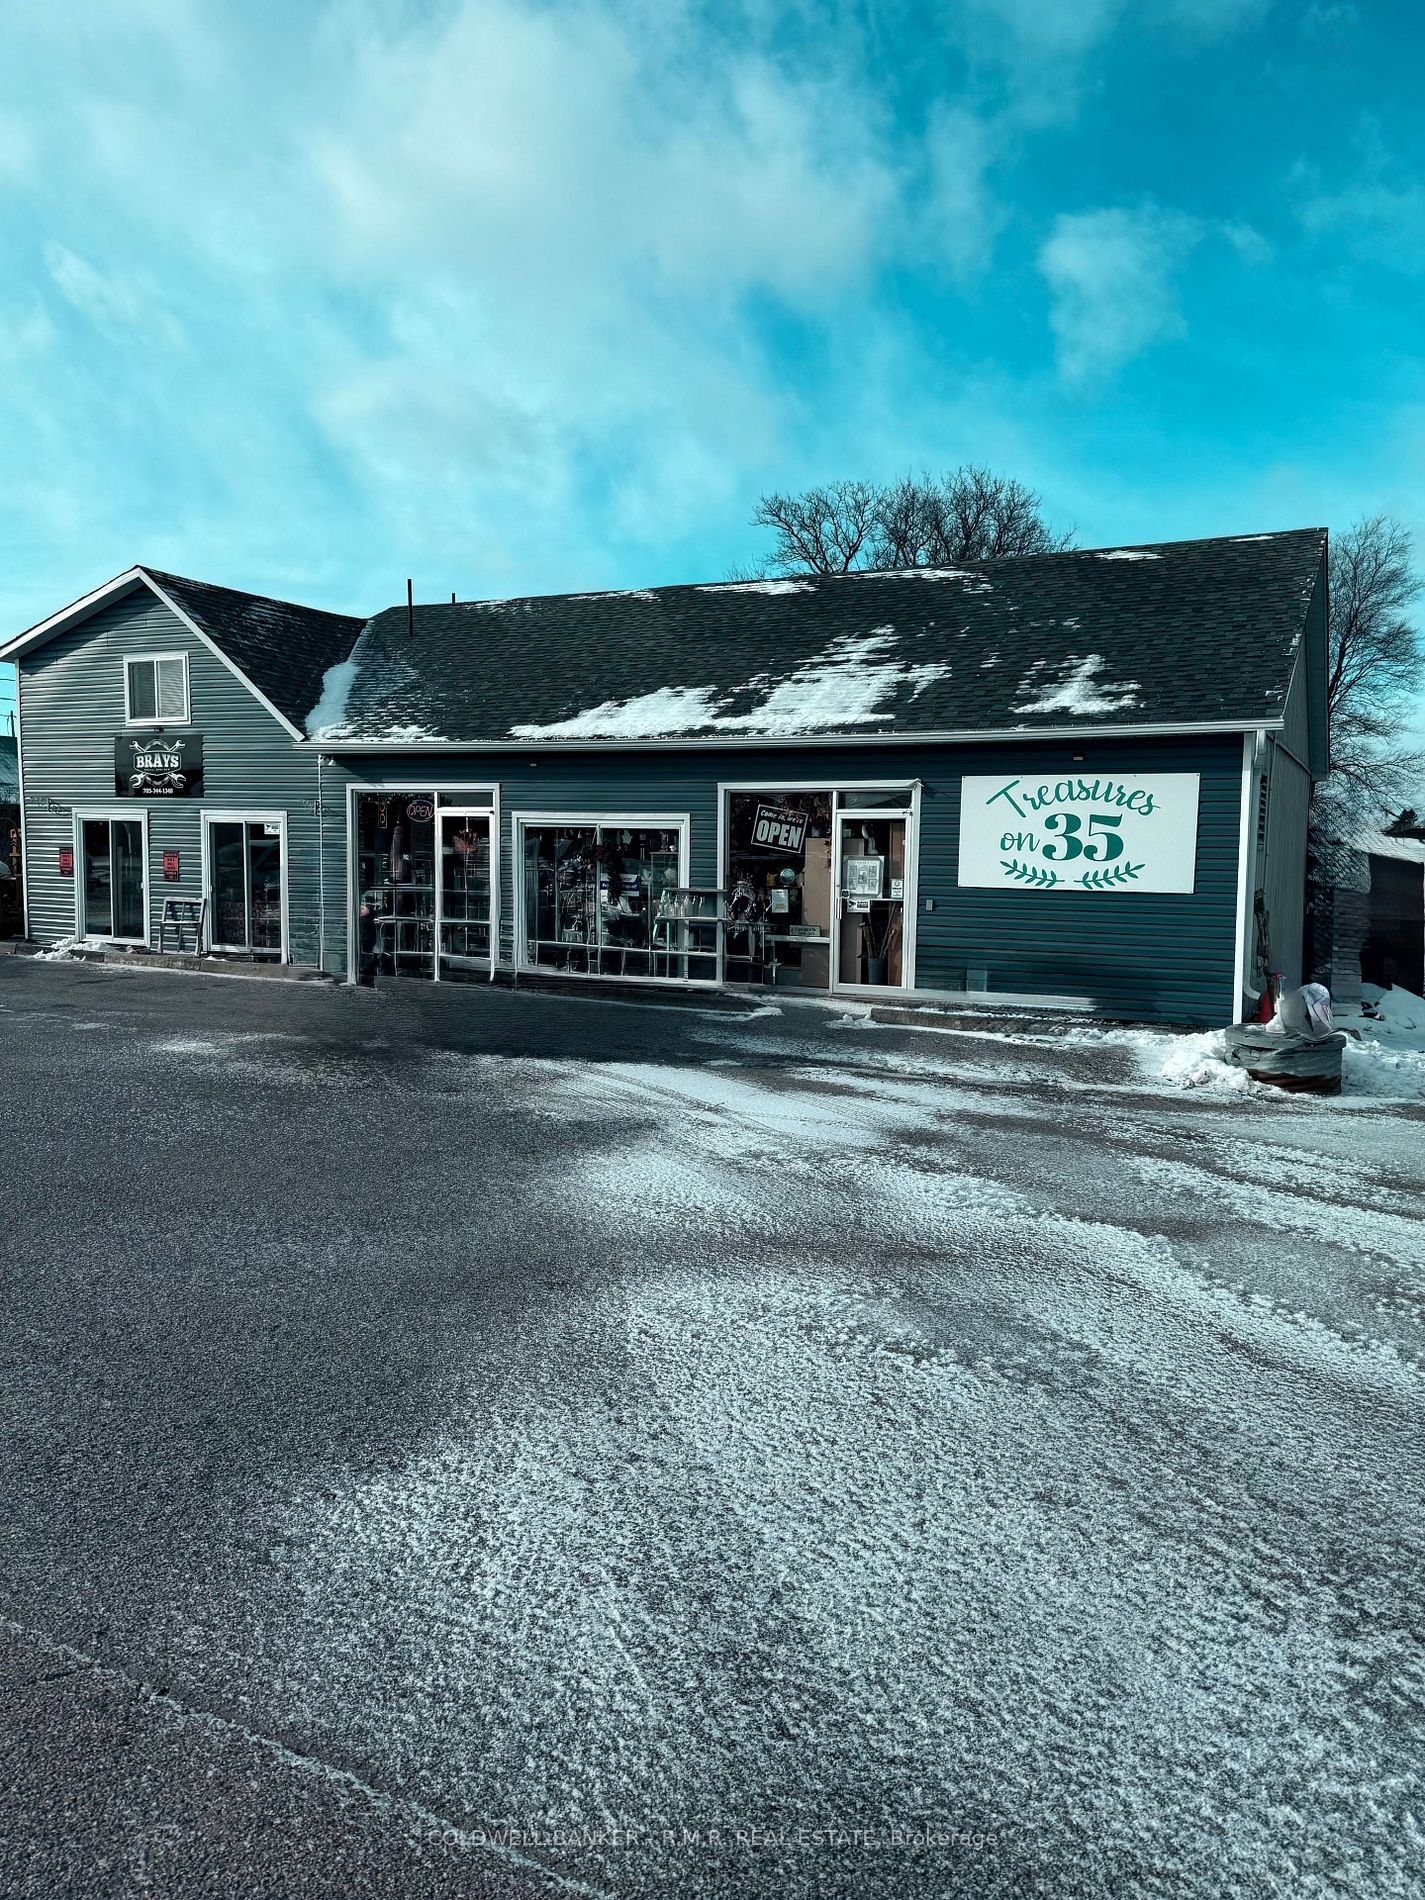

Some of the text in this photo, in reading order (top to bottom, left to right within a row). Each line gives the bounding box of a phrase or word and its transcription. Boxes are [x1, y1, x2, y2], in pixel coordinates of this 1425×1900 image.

[136, 753, 179, 769] BRAYS
[408, 805, 433, 817] OPEN
[985, 779, 1162, 816] Treasures
[756, 819, 802, 849] OPEN
[1000, 813, 1124, 862] on 35
